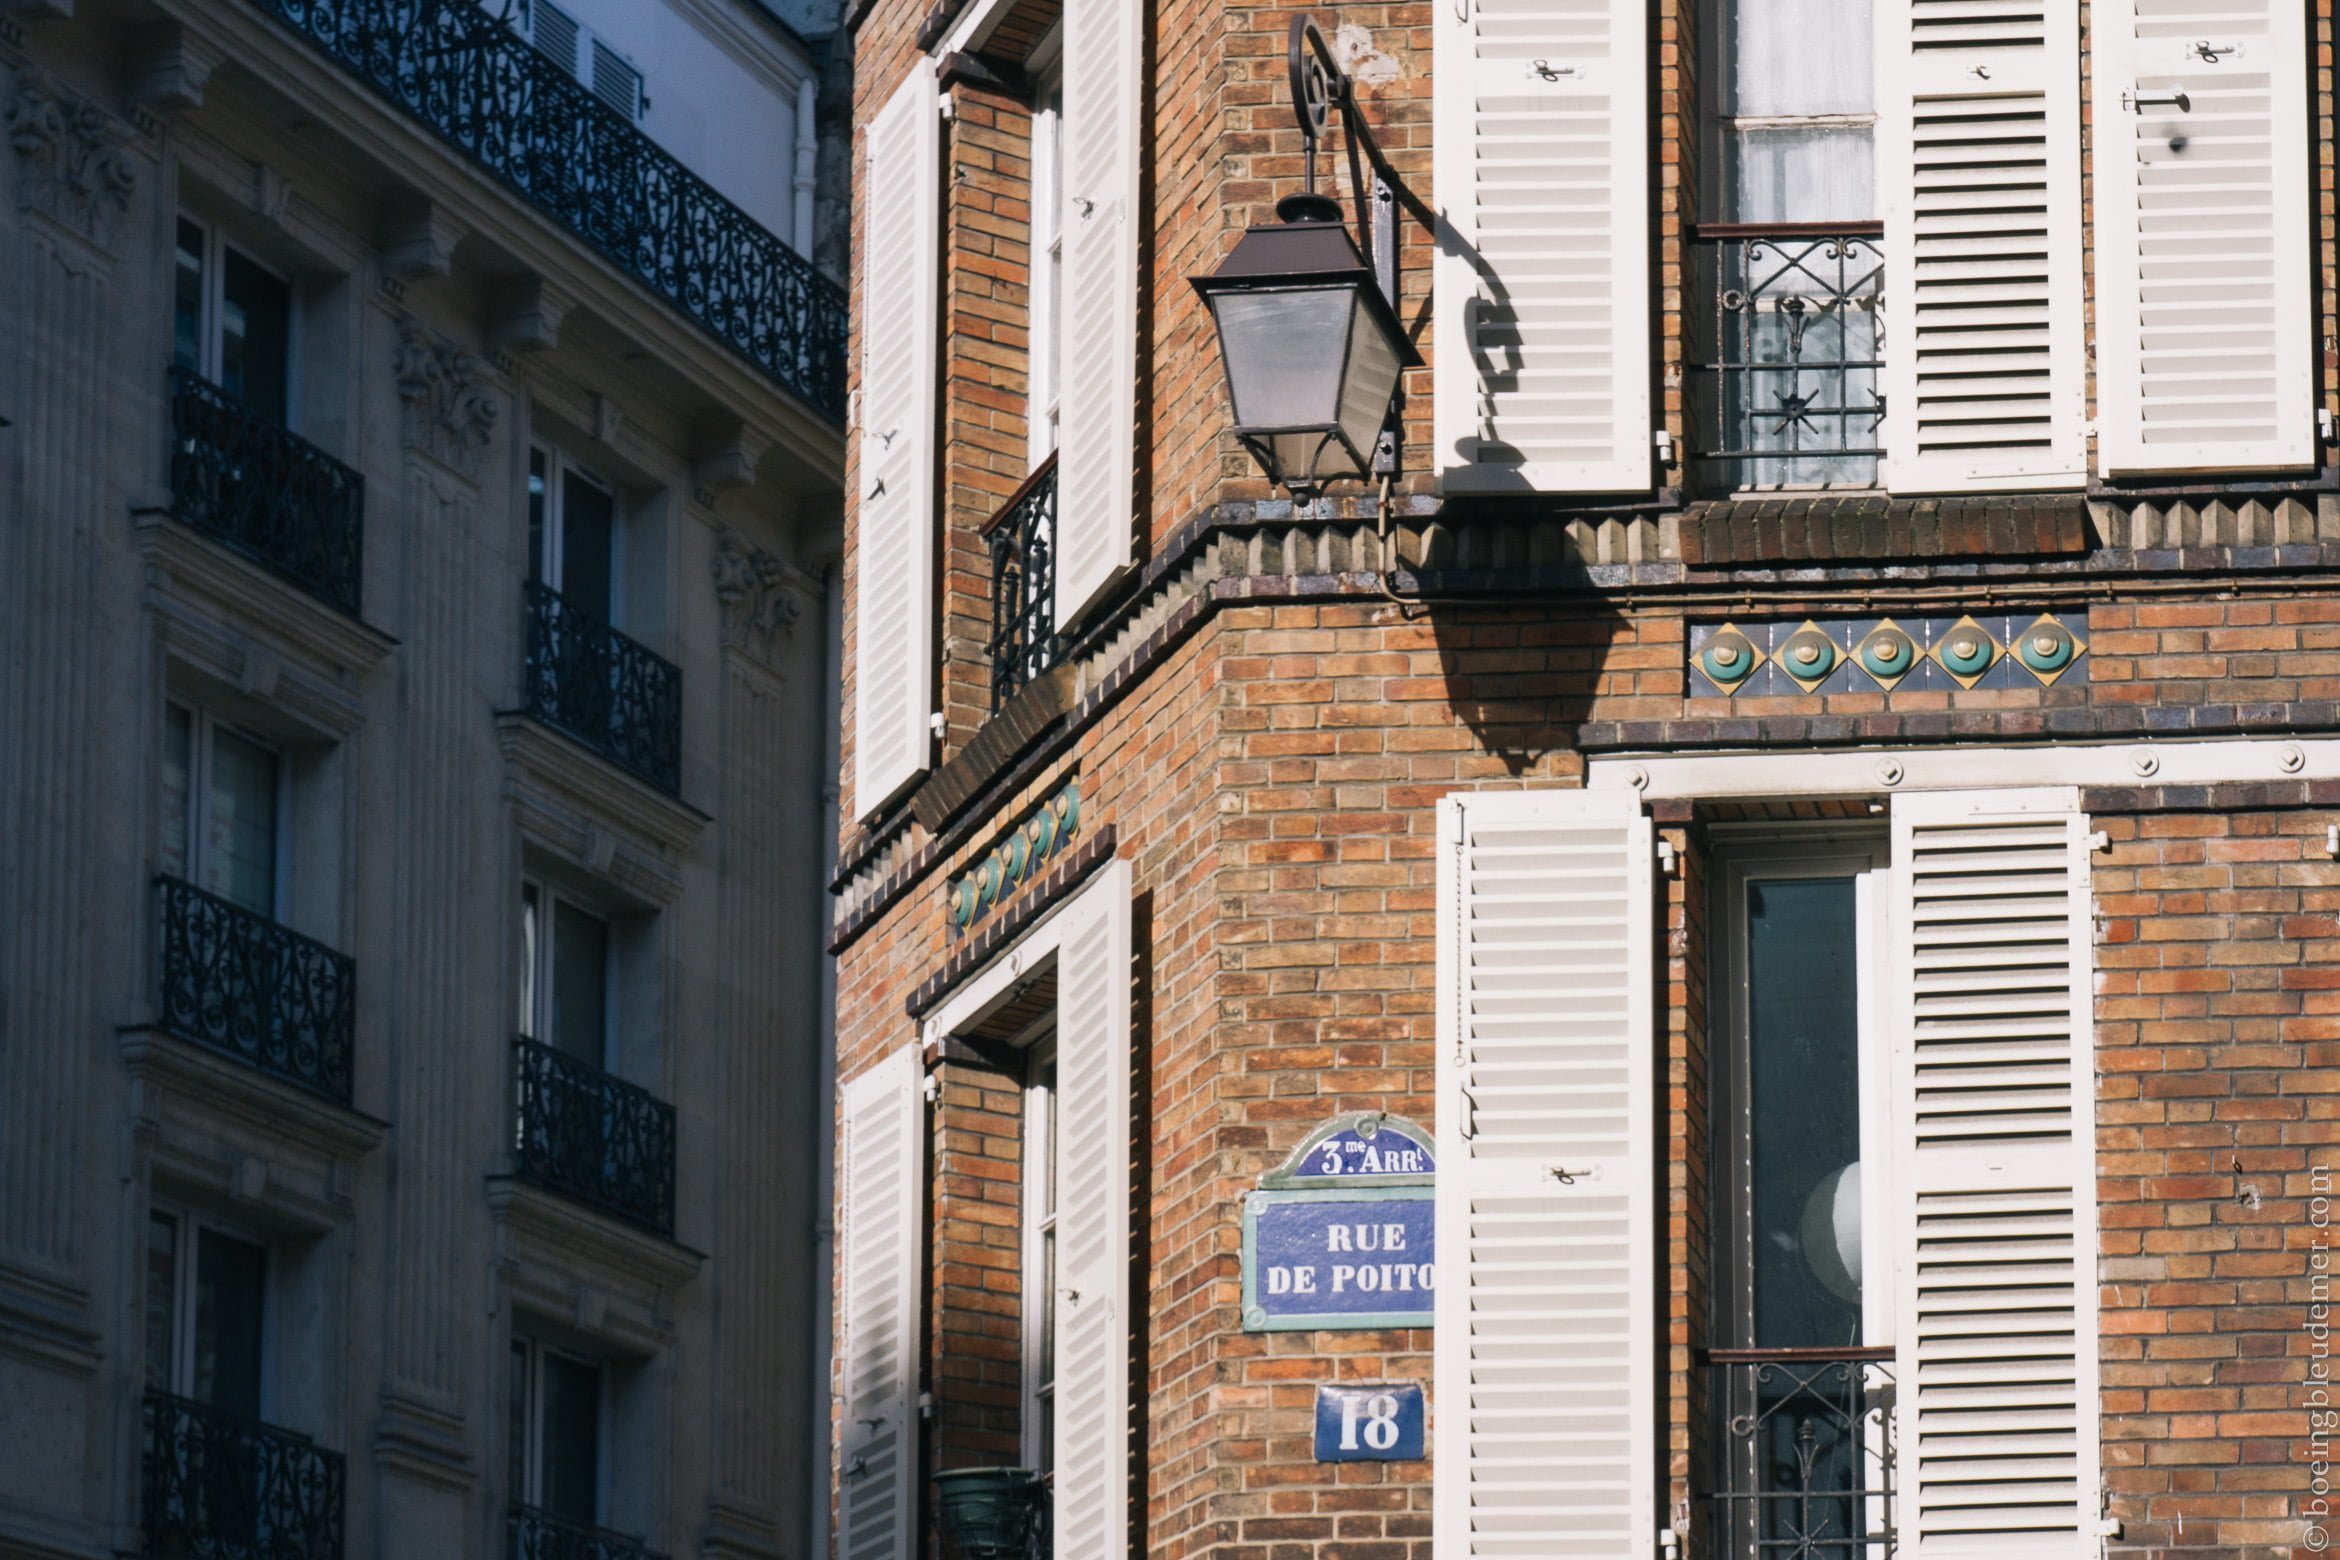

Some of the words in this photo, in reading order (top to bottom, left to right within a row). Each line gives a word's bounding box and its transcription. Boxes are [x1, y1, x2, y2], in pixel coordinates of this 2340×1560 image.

[1327, 1223, 1406, 1252] RUE
[1267, 1265, 1317, 1295] DE
[1338, 1394, 1400, 1450] 18
